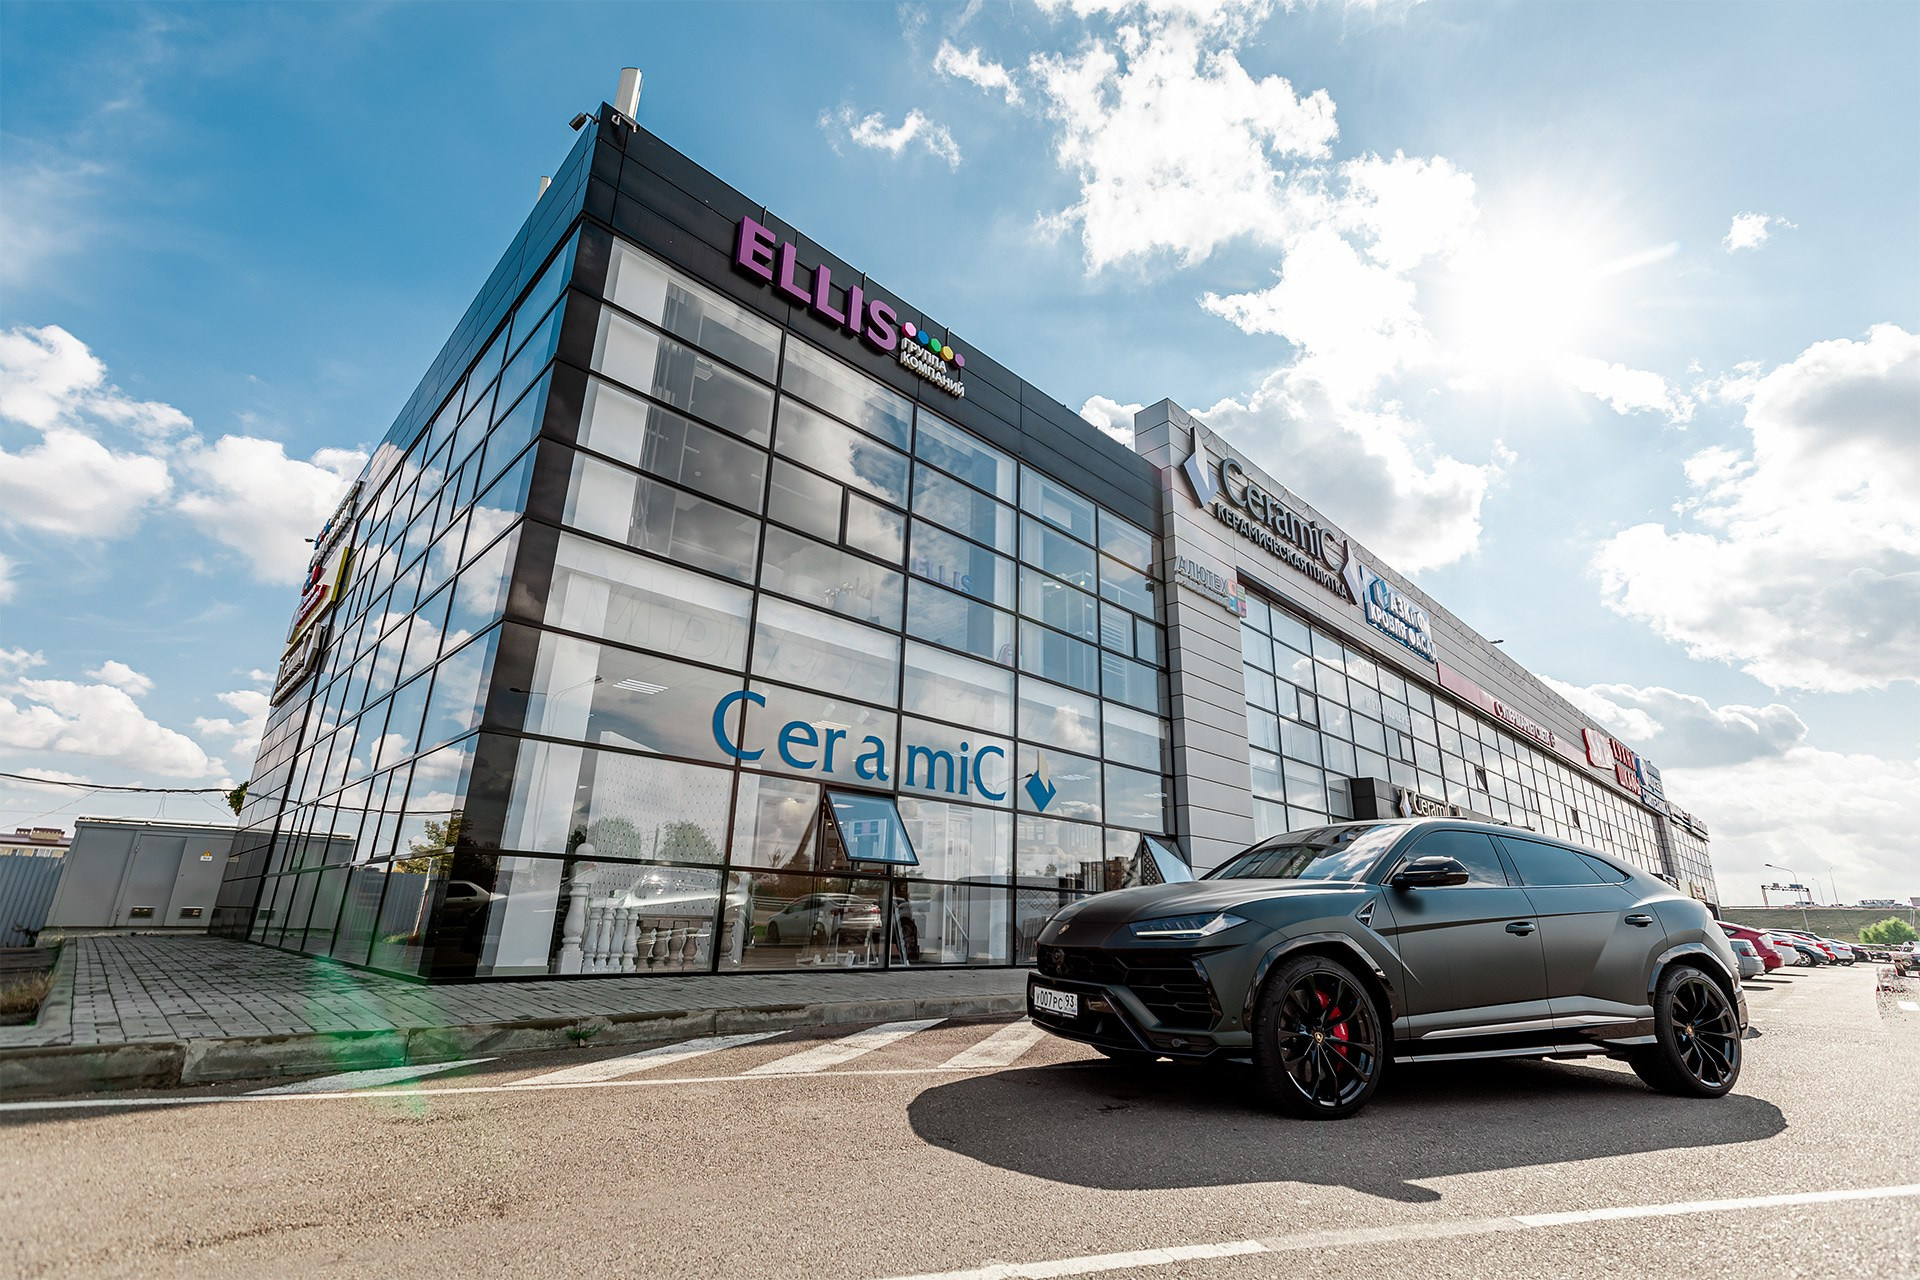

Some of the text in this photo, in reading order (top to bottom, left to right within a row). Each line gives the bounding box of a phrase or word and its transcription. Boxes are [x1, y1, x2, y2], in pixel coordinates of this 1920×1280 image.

[736, 216, 897, 353] ELLIS
[900, 351, 965, 399] КОМПАНИЙ
[901, 337, 947, 373] ГРУППА
[1215, 502, 1348, 600] КЕРАМИЧЕСКАЯ ПЛИТКА
[1219, 458, 1342, 573] CeramiC
[1174, 555, 1230, 597] АЛЮТЕХ
[1367, 602, 1438, 661] КРОВЛЯ ФАСАД
[712, 690, 1007, 802] CeramiC
